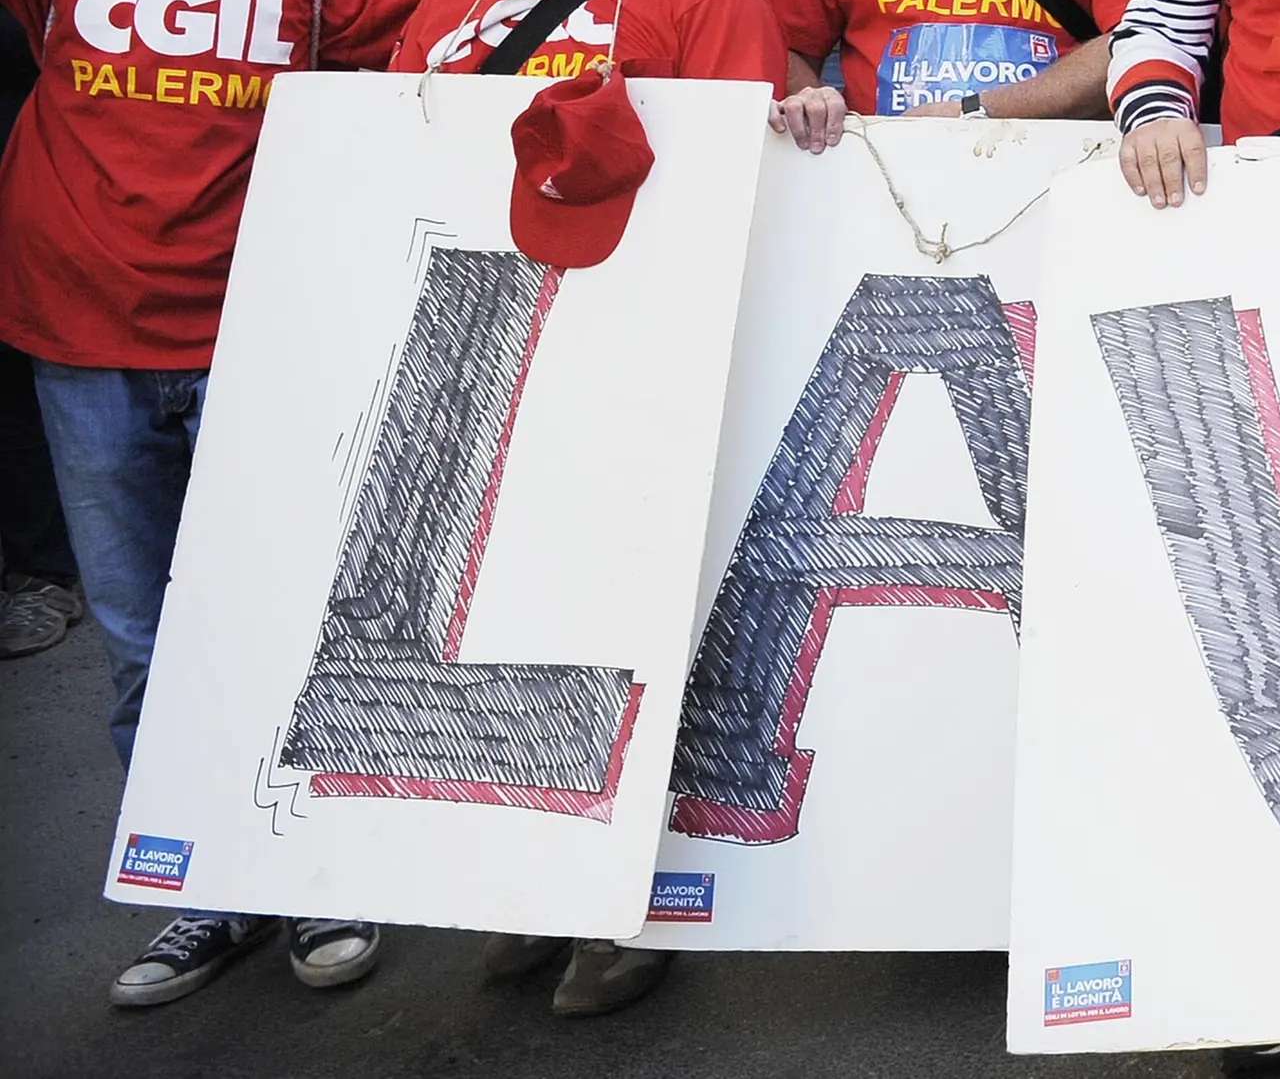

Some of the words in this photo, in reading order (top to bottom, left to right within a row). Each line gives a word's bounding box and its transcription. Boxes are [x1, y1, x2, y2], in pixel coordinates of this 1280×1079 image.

[922, 61, 1037, 83] LAVORO
[128, 848, 138, 858] IL
[140, 849, 183, 864] LAVORO
[134, 860, 179, 876] DIGNITÀ
[657, 885, 705, 895] LAVORO
[653, 896, 703, 907] DIGNITÀ
[1051, 983, 1064, 995] IL
[1067, 977, 1123, 993] LAVORO
[1052, 995, 1061, 1009] È
[1064, 988, 1122, 1008] DIGNITÀ
